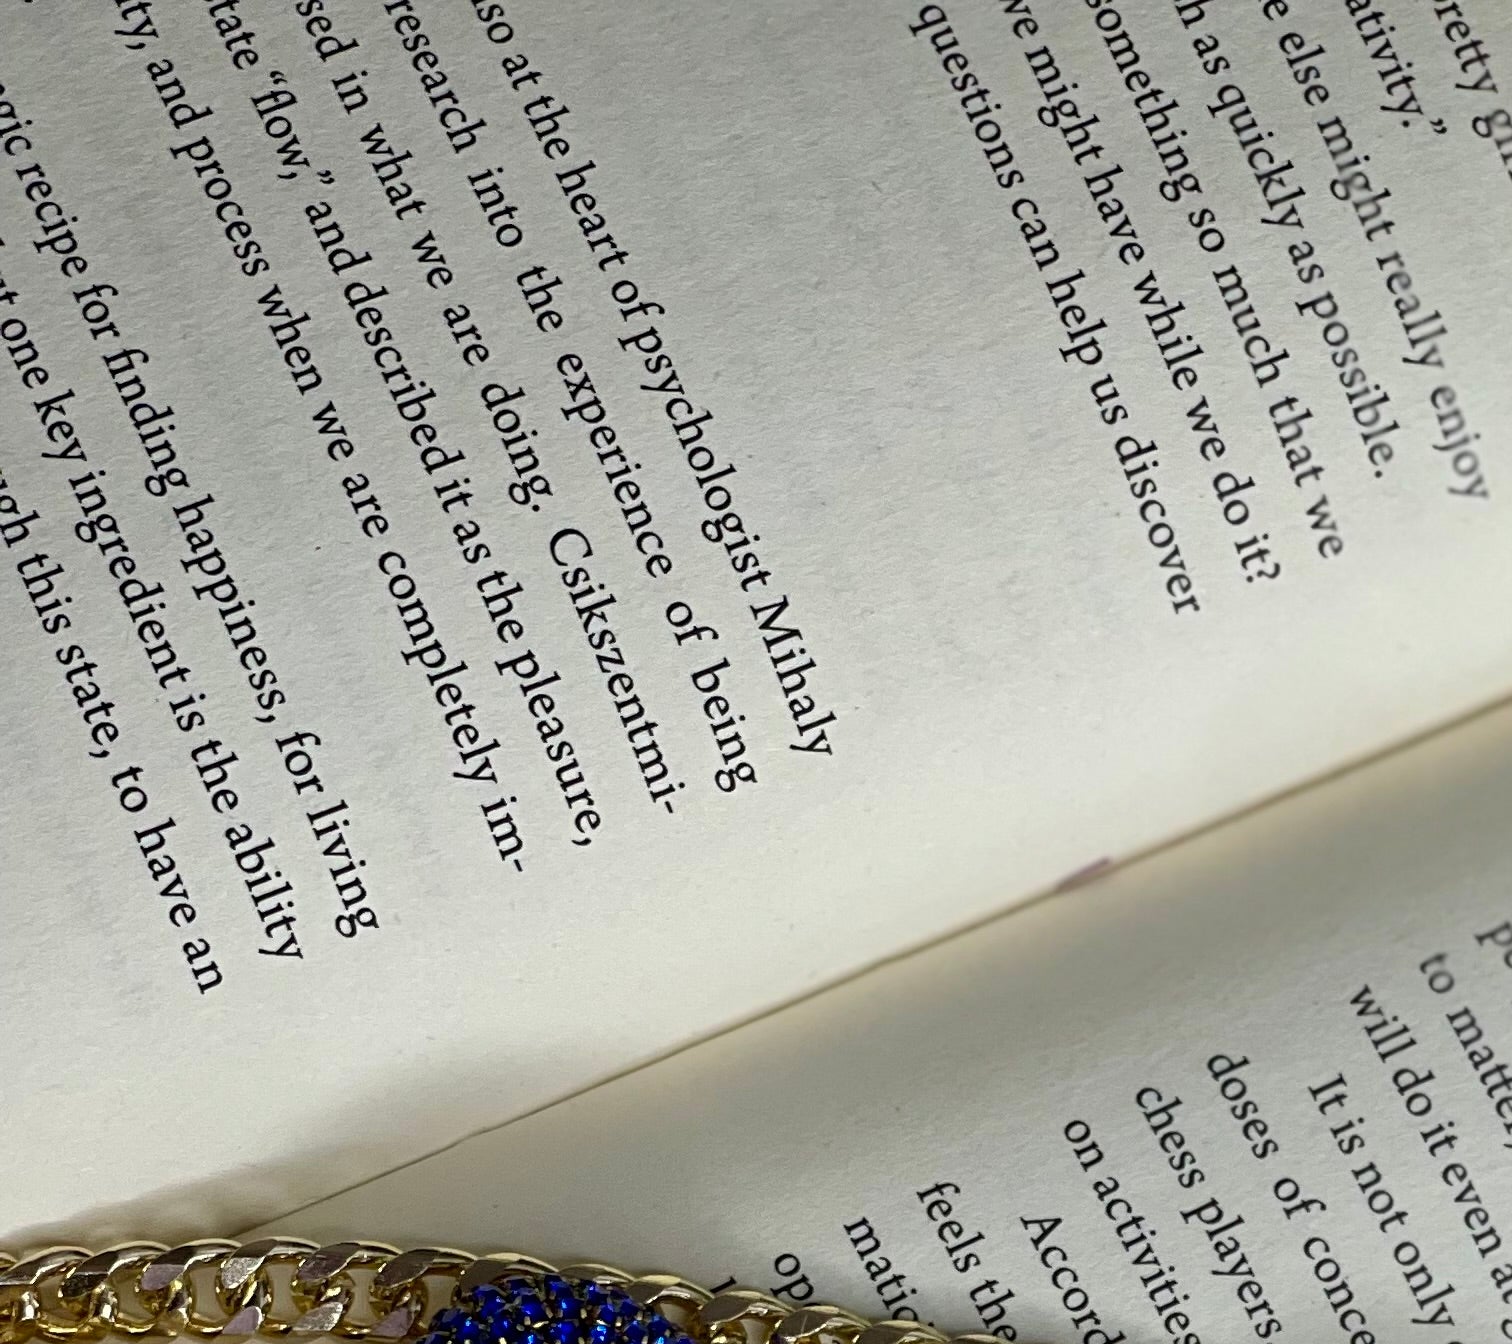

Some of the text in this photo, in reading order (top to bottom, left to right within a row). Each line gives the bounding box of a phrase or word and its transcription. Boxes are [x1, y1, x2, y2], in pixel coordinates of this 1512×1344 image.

[14, 162, 380, 939] recipe for finding happiness, for living
[145, 58, 524, 873] and process when we are completely im-
[249, 69, 602, 847] “flow,” and described it as the pleasure,
[329, 68, 686, 815] in what we are doing. Csikszentmi-
[382, 0, 758, 793] research into the experience of being
[500, 53, 837, 755] at the heart of psychologist Mihaly
[908, 4, 1201, 615] questions can help us discover
[1024, 45, 1282, 584] might have while we do it?
[1085, 0, 1344, 559] something so much that we
[1277, 31, 1490, 499] else might really enjoy
[15, 552, 223, 995] this state, to have an
[1418, 952, 1456, 995] to
[1349, 984, 1418, 1064] will
[1391, 1067, 1436, 1117] do
[1419, 1120, 1459, 1158] it
[1440, 1162, 1502, 1259] even
